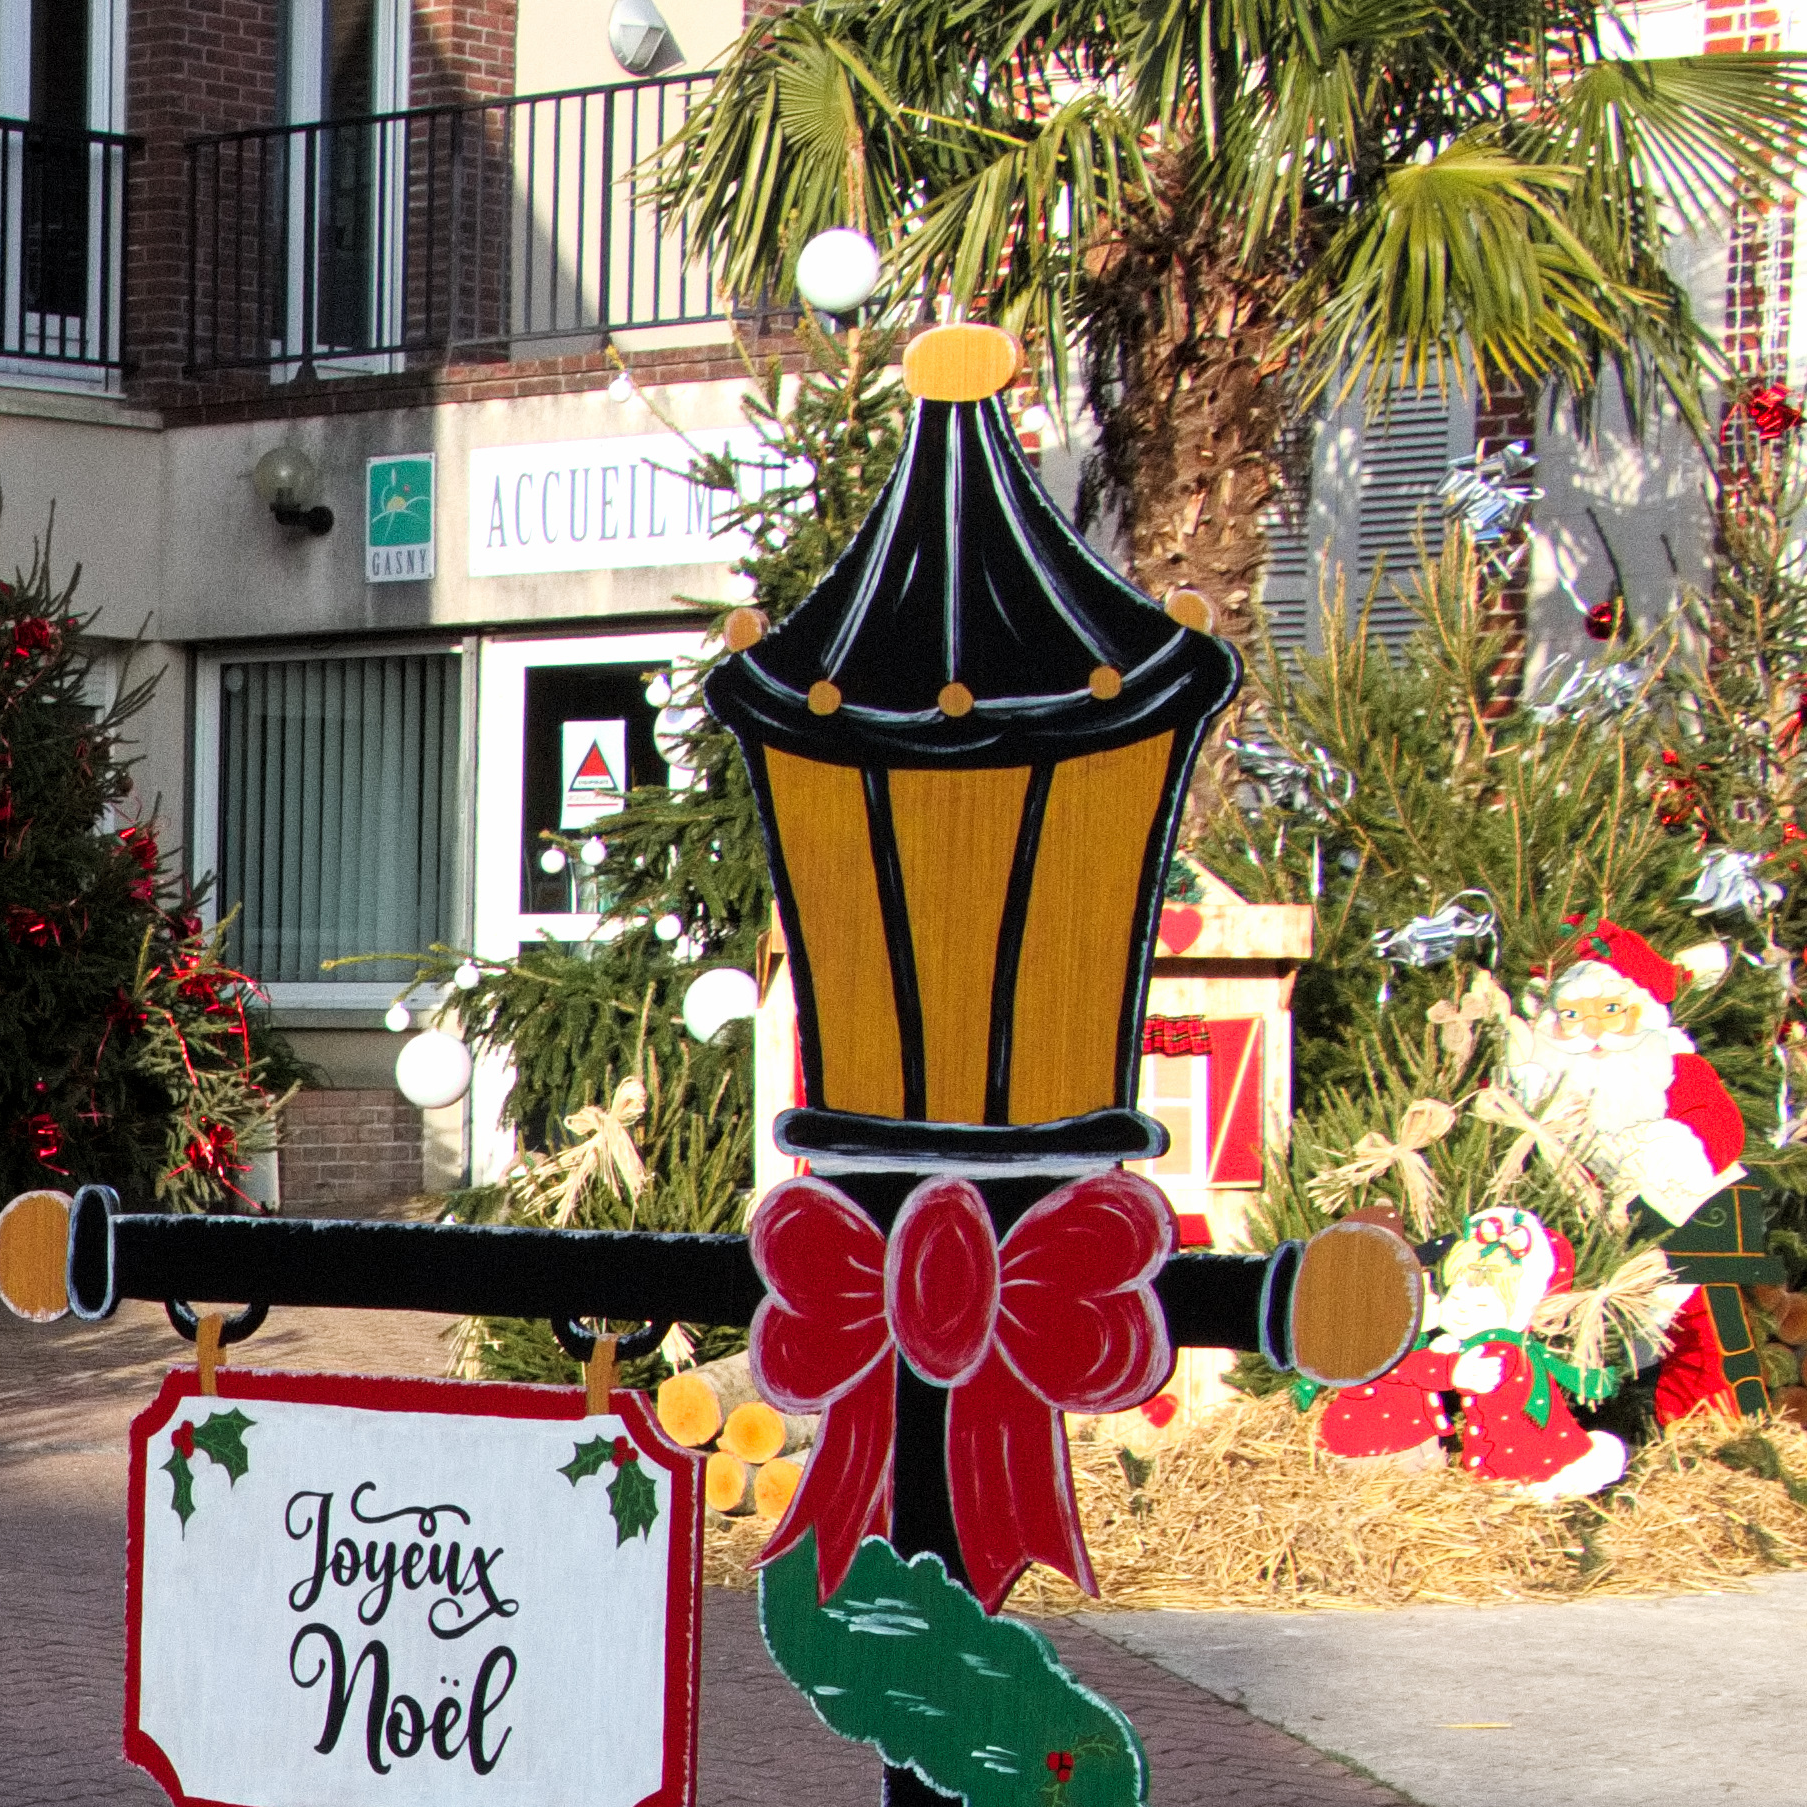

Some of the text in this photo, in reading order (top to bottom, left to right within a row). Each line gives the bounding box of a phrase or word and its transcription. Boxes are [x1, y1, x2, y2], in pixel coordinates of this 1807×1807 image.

[371, 548, 427, 577] GASNY
[486, 463, 667, 549] ACCUEIL
[284, 1481, 519, 1640] Joyeux
[289, 1622, 518, 1776] Noël
